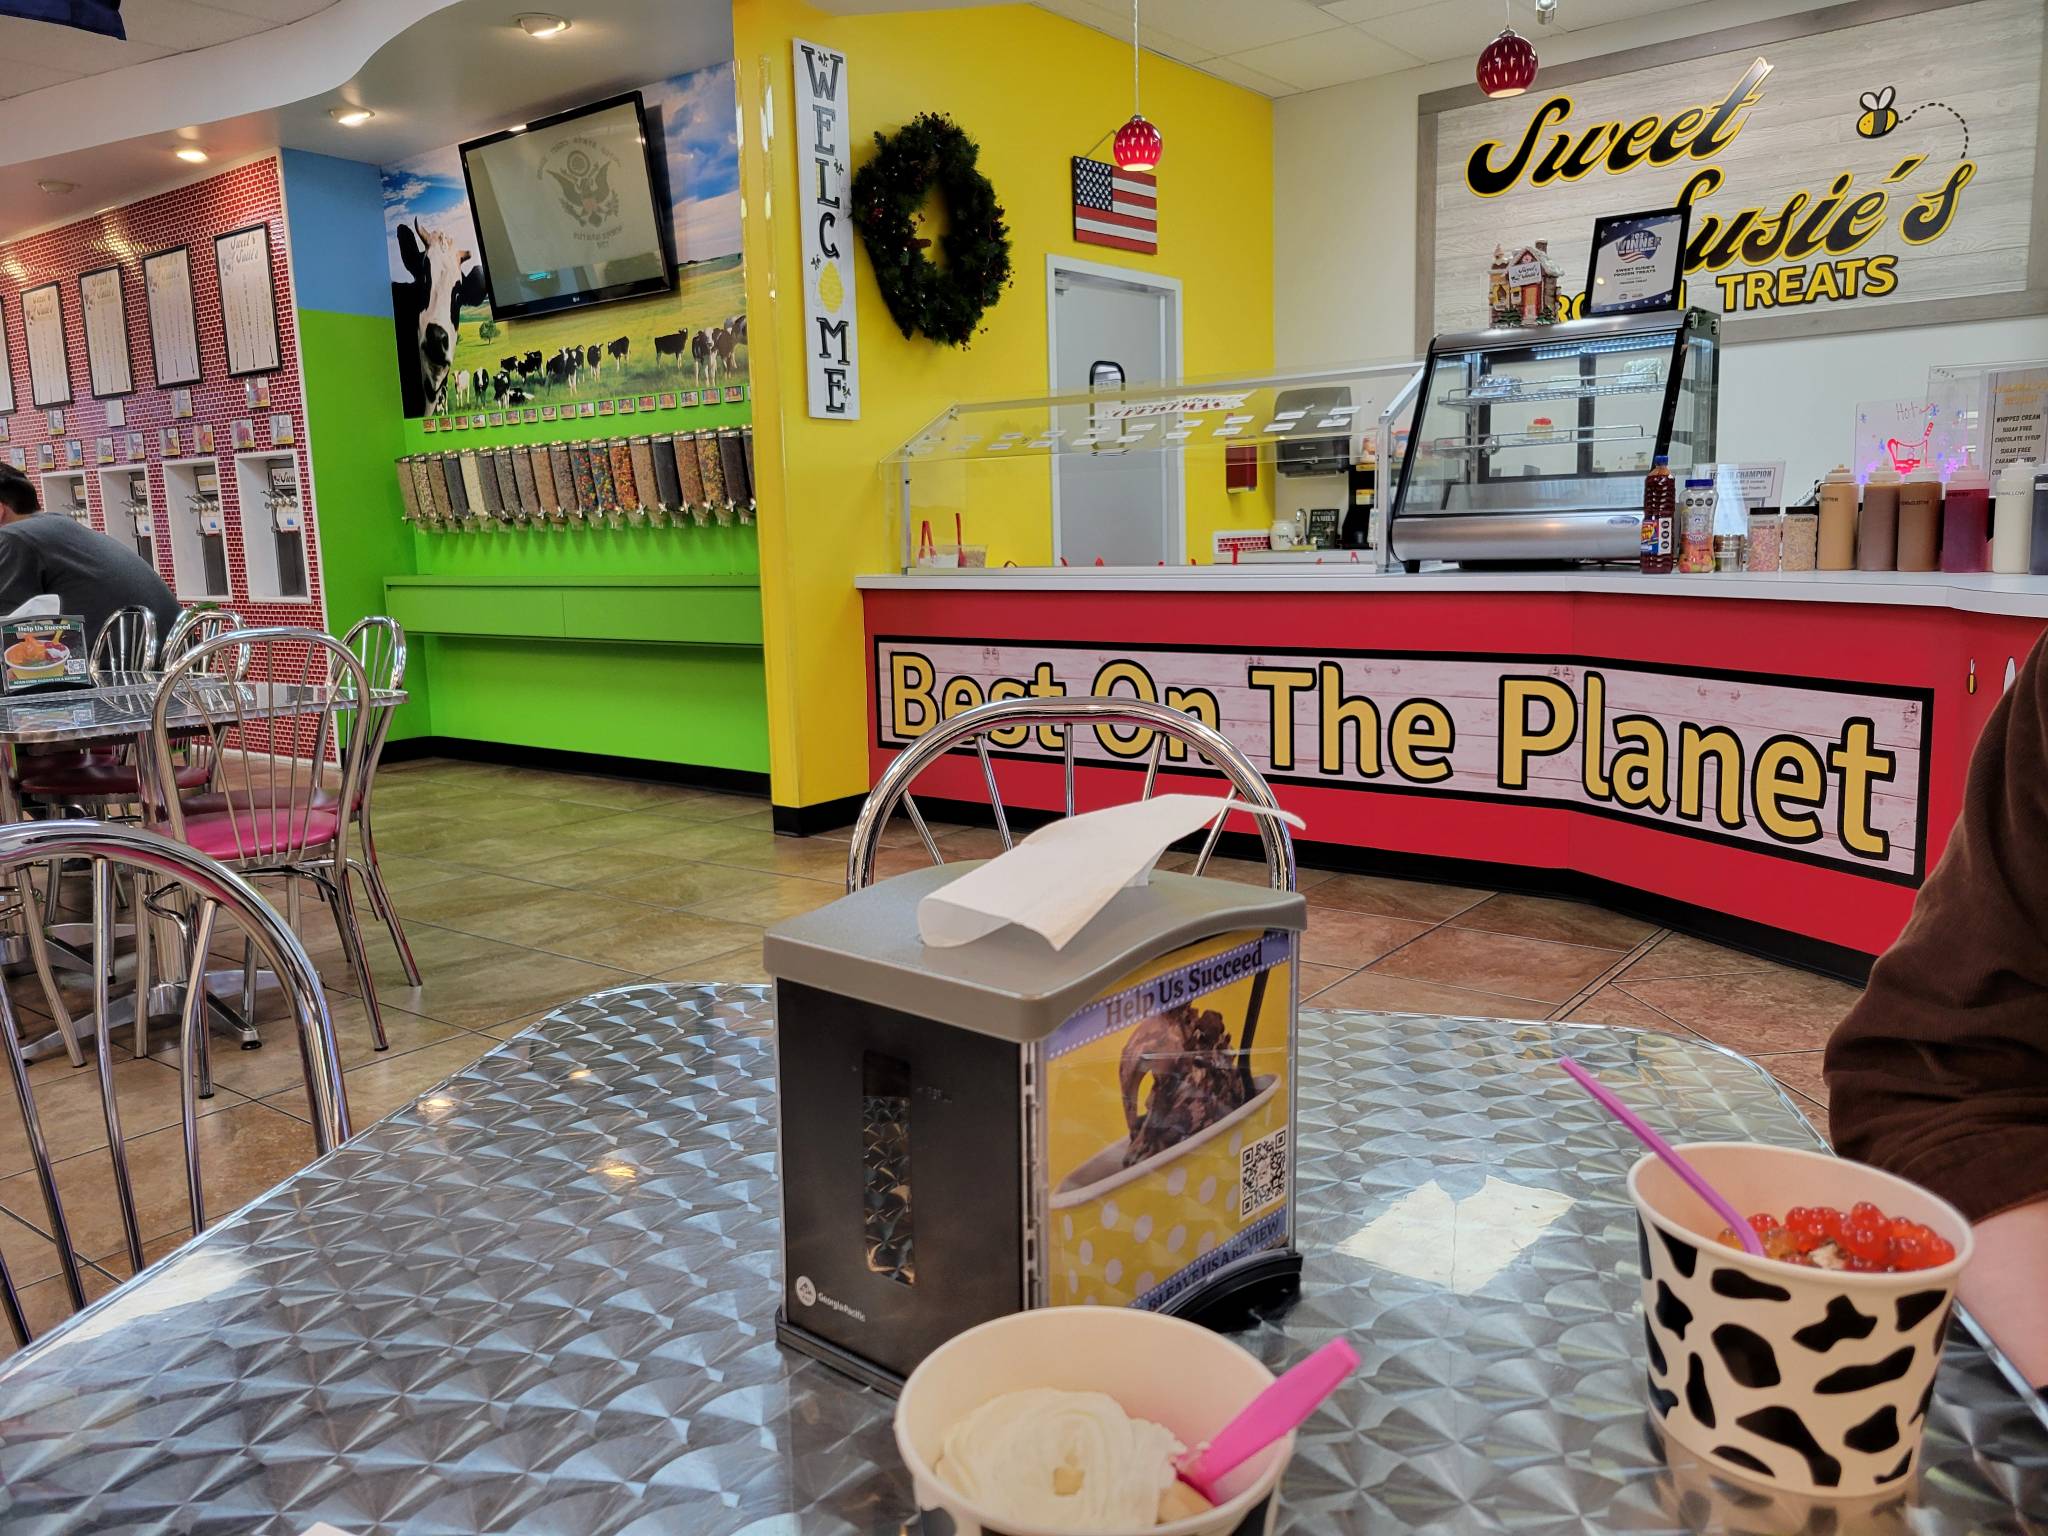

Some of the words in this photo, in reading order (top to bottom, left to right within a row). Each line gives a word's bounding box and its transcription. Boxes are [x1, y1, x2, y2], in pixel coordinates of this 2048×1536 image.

[1465, 56, 1775, 198] Sweet
[1616, 236, 1662, 252] WINNER
[1716, 255, 1899, 313] TREATS
[1736, 470, 1772, 479] CHAMPION
[890, 651, 1068, 749] Best
[1091, 658, 1221, 766] On
[1248, 661, 1456, 783] The
[1495, 670, 1897, 862] Planet
[1105, 988, 1155, 1027] Help
[1158, 977, 1184, 1004] Us
[1188, 942, 1263, 993] Succeed
[1221, 1251, 1230, 1267] A
[1231, 1218, 1280, 1260] REVIEW
